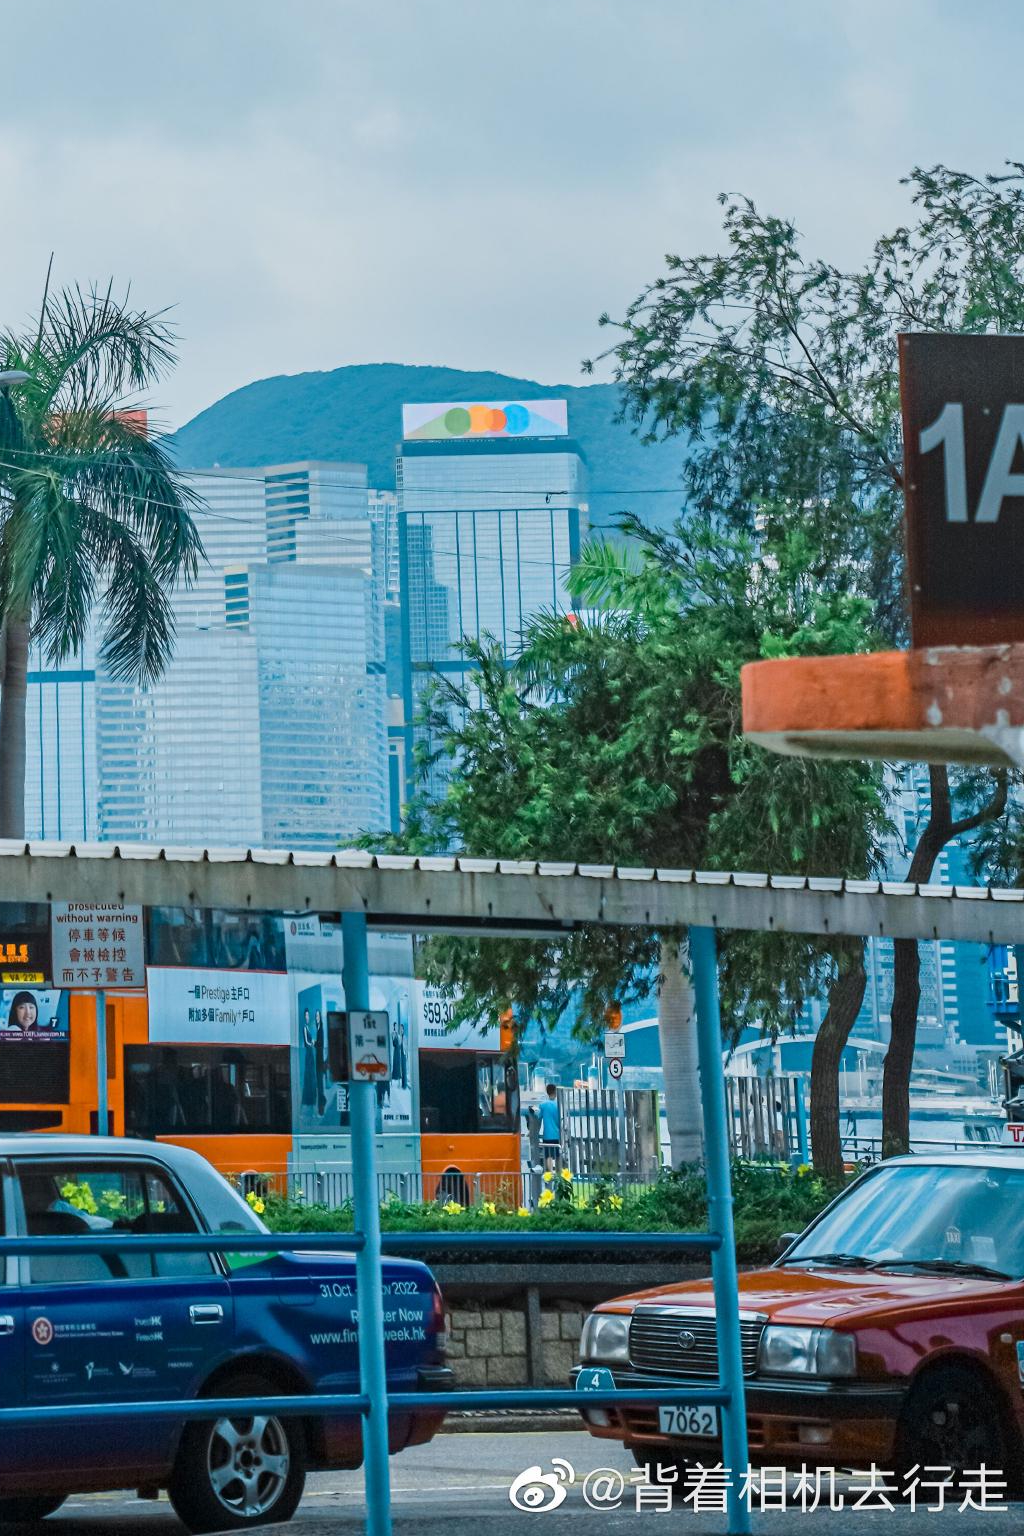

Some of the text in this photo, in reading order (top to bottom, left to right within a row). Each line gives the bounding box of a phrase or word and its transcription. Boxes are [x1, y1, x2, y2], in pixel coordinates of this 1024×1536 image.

[56, 913, 138, 924] without warning
[68, 927, 126, 943] 停車等候
[69, 947, 127, 962] 會被檢控
[62, 966, 135, 983] 而不予警告
[1007, 1124, 1024, 1143] T
[332, 1282, 353, 1297] Oct
[391, 1281, 420, 1296] 2022
[398, 1307, 424, 1322] Now
[310, 1325, 427, 1345] www.finweek.hk
[591, 1373, 600, 1388] 4
[663, 1410, 714, 1435] 7062
